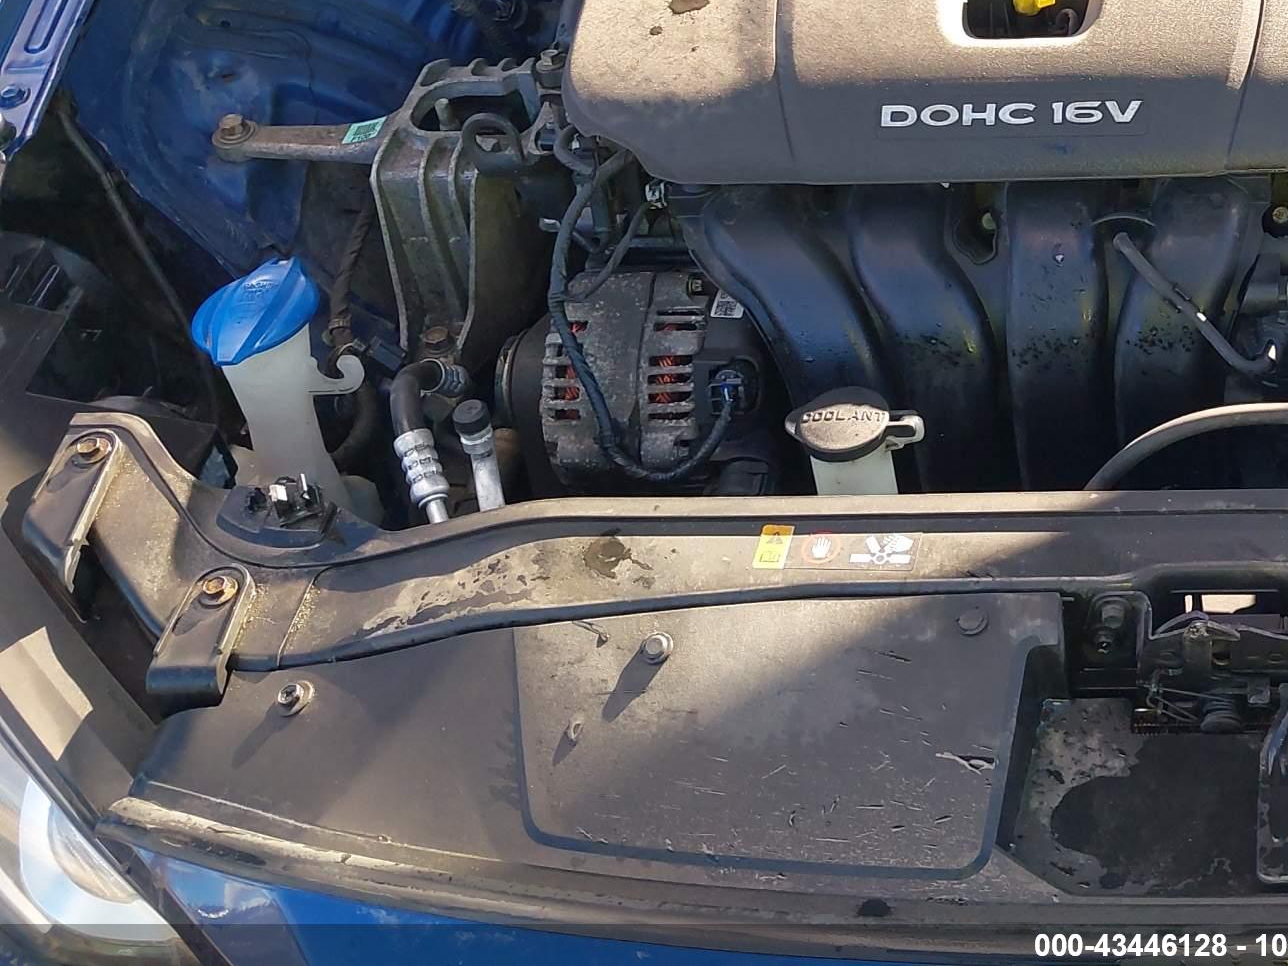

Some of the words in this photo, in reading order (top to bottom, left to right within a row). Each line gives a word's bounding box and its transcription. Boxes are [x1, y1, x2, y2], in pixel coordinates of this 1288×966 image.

[880, 102, 1037, 127] DOHC
[1051, 100, 1145, 124] 16V
[802, 411, 885, 423] COOLANT
